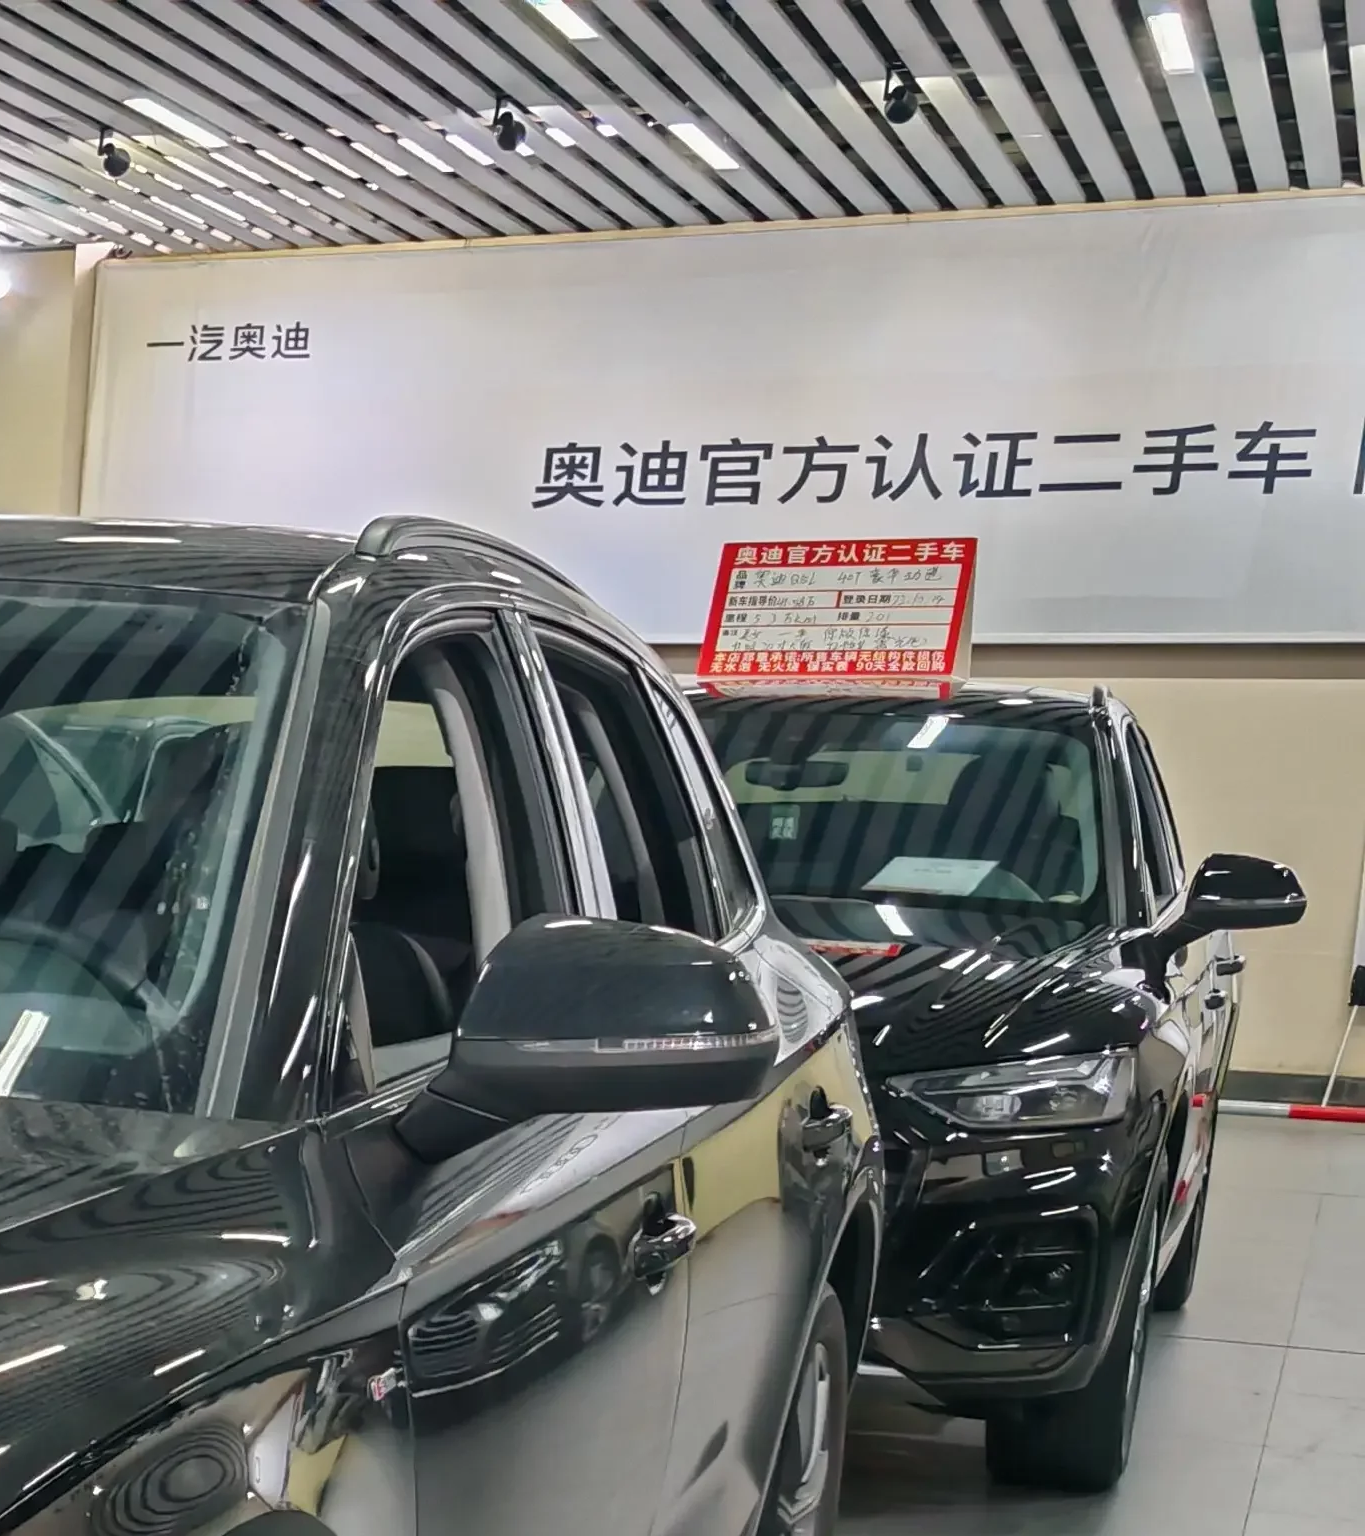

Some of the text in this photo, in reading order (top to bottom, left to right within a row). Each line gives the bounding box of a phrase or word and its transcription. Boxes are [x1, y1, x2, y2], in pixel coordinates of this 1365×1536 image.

[147, 322, 310, 361] 一汽奥迪
[531, 421, 1317, 508] 奥迪官方认证二手车
[734, 542, 966, 566] 奥迪官方认证二手车
[843, 594, 891, 604] 登录日期
[855, 660, 946, 672] 90天全款回购
